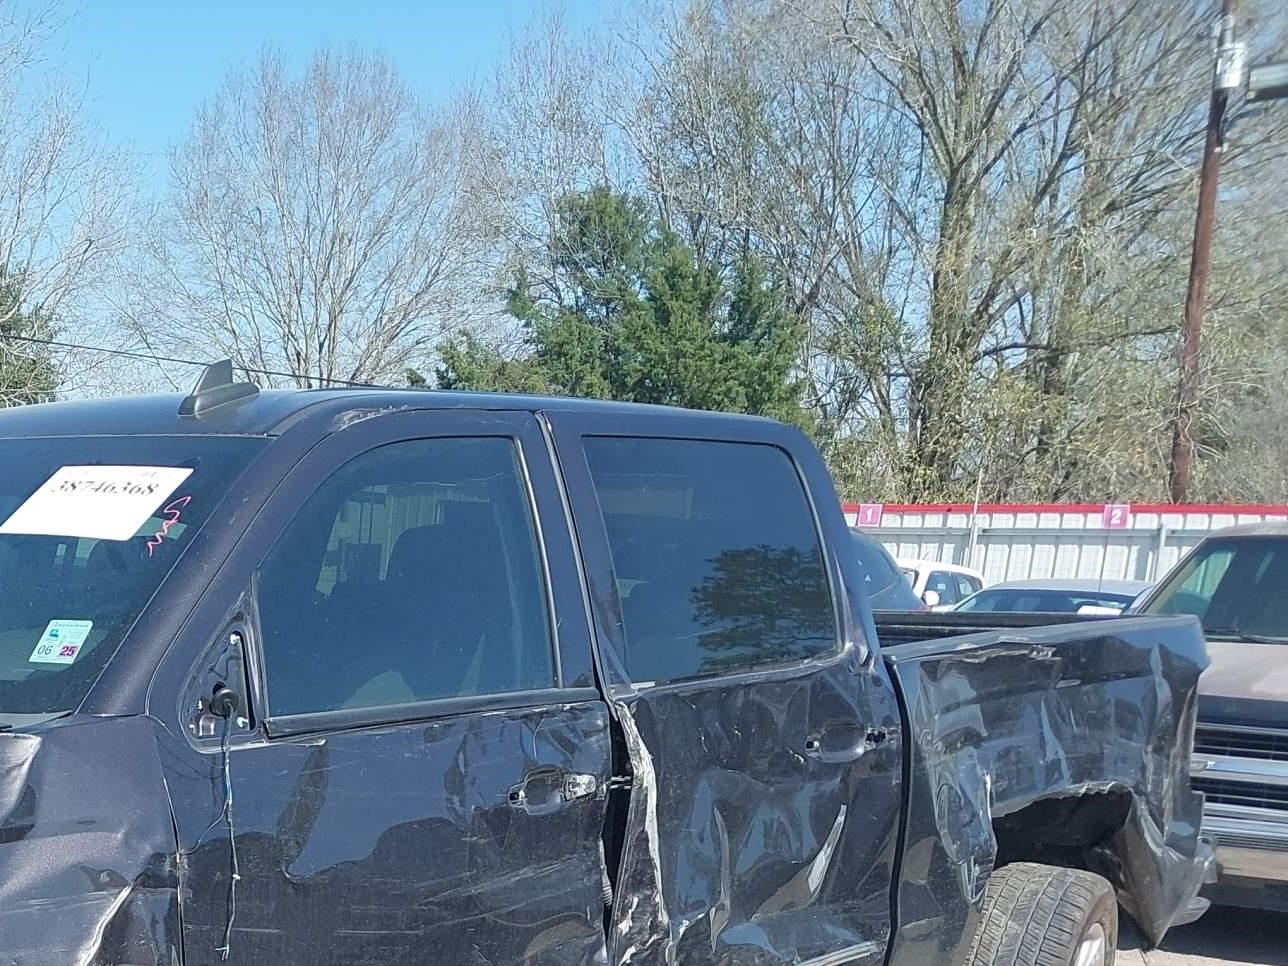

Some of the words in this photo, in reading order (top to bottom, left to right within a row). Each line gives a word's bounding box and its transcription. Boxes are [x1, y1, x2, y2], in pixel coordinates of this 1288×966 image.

[52, 480, 160, 496] 38746368
[1111, 508, 1122, 524] 2
[37, 645, 54, 656] 06
[59, 645, 79, 657] 25
